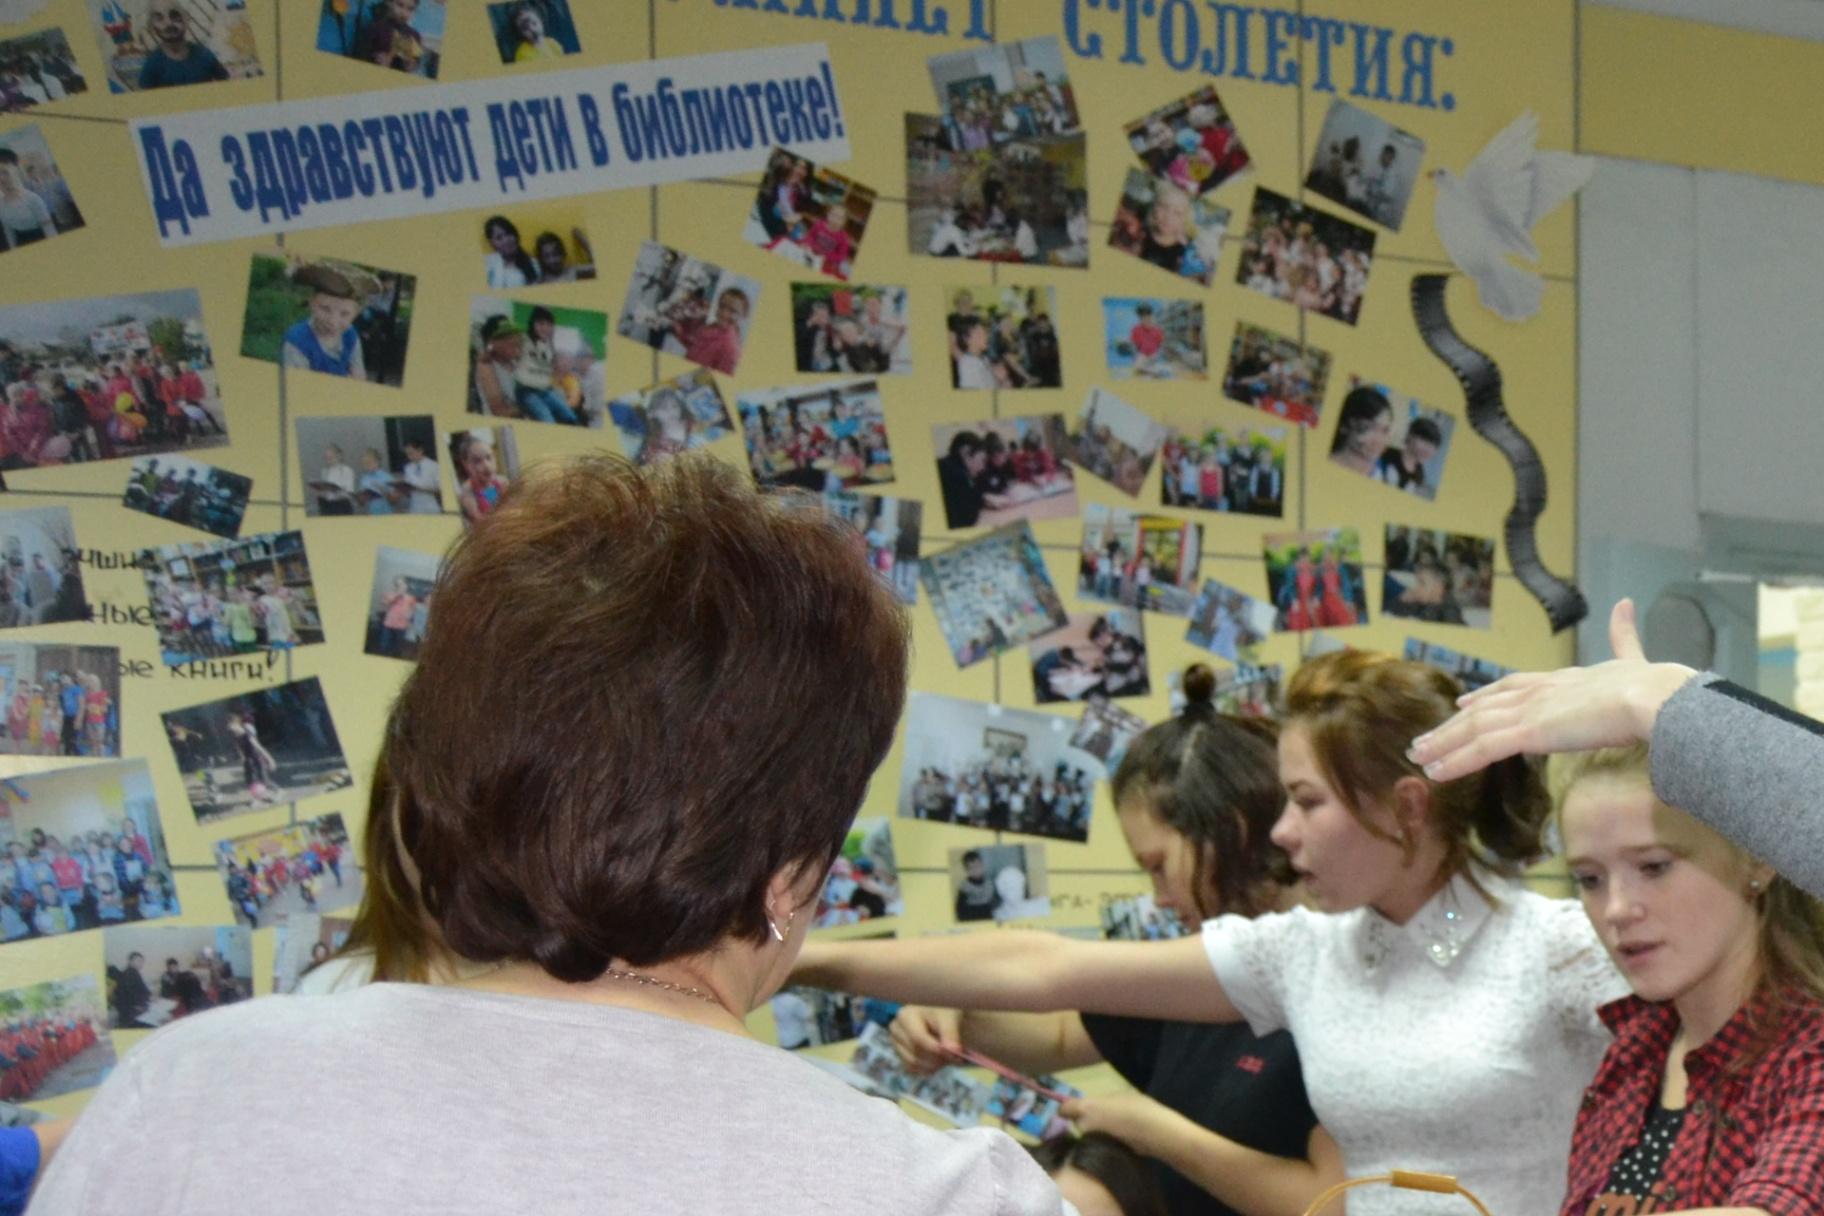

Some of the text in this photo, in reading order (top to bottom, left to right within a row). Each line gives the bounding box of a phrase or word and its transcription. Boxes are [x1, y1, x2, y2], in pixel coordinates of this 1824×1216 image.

[1062, 0, 1456, 112] СТОЛЕТИЯ:
[138, 60, 844, 238] Да здравствуют дети в библиотеке!
